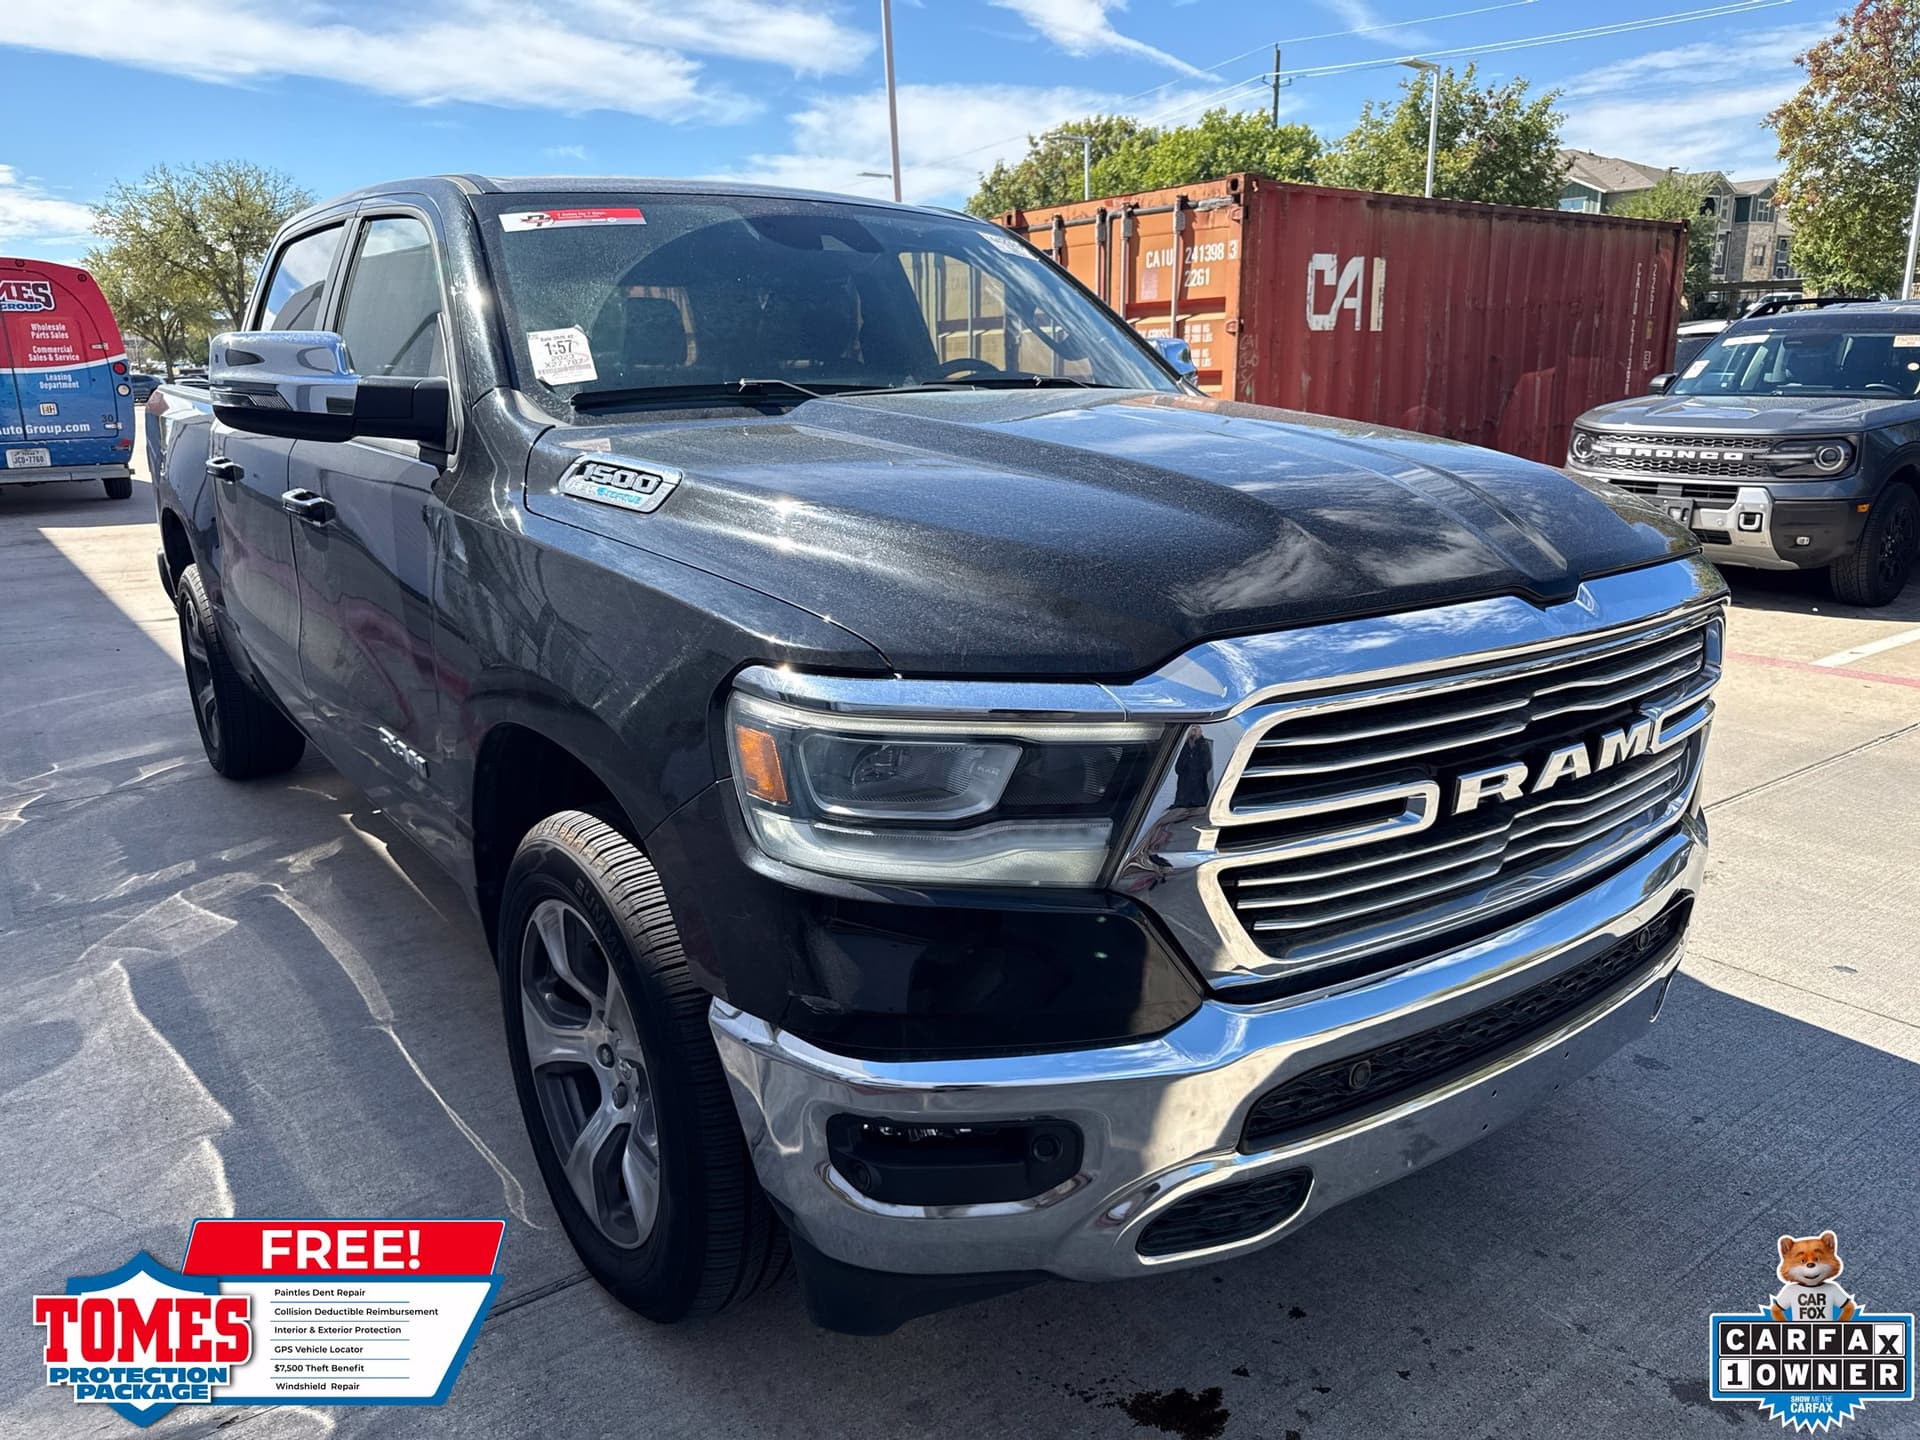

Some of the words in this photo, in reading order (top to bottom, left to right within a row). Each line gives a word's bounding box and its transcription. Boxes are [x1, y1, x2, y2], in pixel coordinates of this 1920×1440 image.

[1146, 248, 1173, 268] CAIU
[1185, 242, 1224, 264] 241398
[1228, 240, 1237, 259] 3
[1306, 254, 1386, 332] CAI
[31, 323, 66, 331] Wholesale
[31, 331, 50, 339] Parts
[50, 331, 69, 339] Sales
[32, 345, 73, 353] Commercial
[544, 340, 572, 355] 1:57
[28, 353, 47, 361] Sales
[54, 353, 80, 361] Service
[45, 373, 72, 382] Leasing
[39, 381, 80, 391] Department
[1616, 448, 1743, 460] BRONCO
[584, 464, 660, 493] 1500
[1453, 718, 1652, 816] RAM
